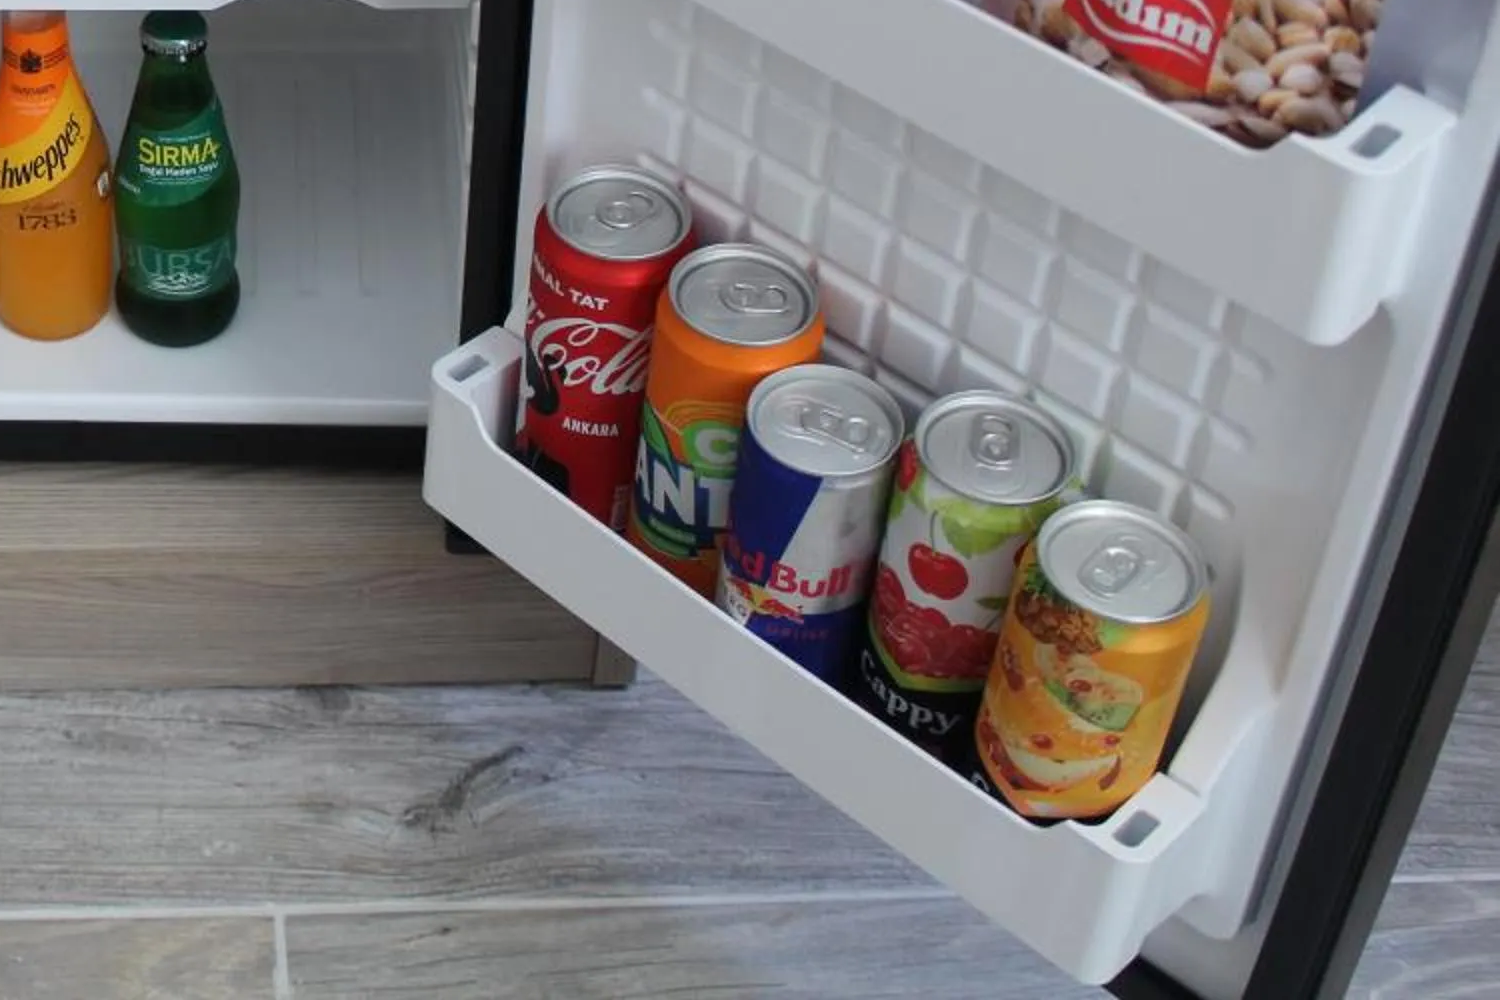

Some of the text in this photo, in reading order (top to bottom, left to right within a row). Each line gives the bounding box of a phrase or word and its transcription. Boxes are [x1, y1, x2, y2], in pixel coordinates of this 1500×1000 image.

[139, 137, 219, 167] SIRMA
[568, 288, 610, 311] TAT
[562, 417, 620, 437] ANKARA
[635, 433, 735, 529] ANT
[767, 561, 851, 598] Bull
[860, 649, 964, 736] Cappy
